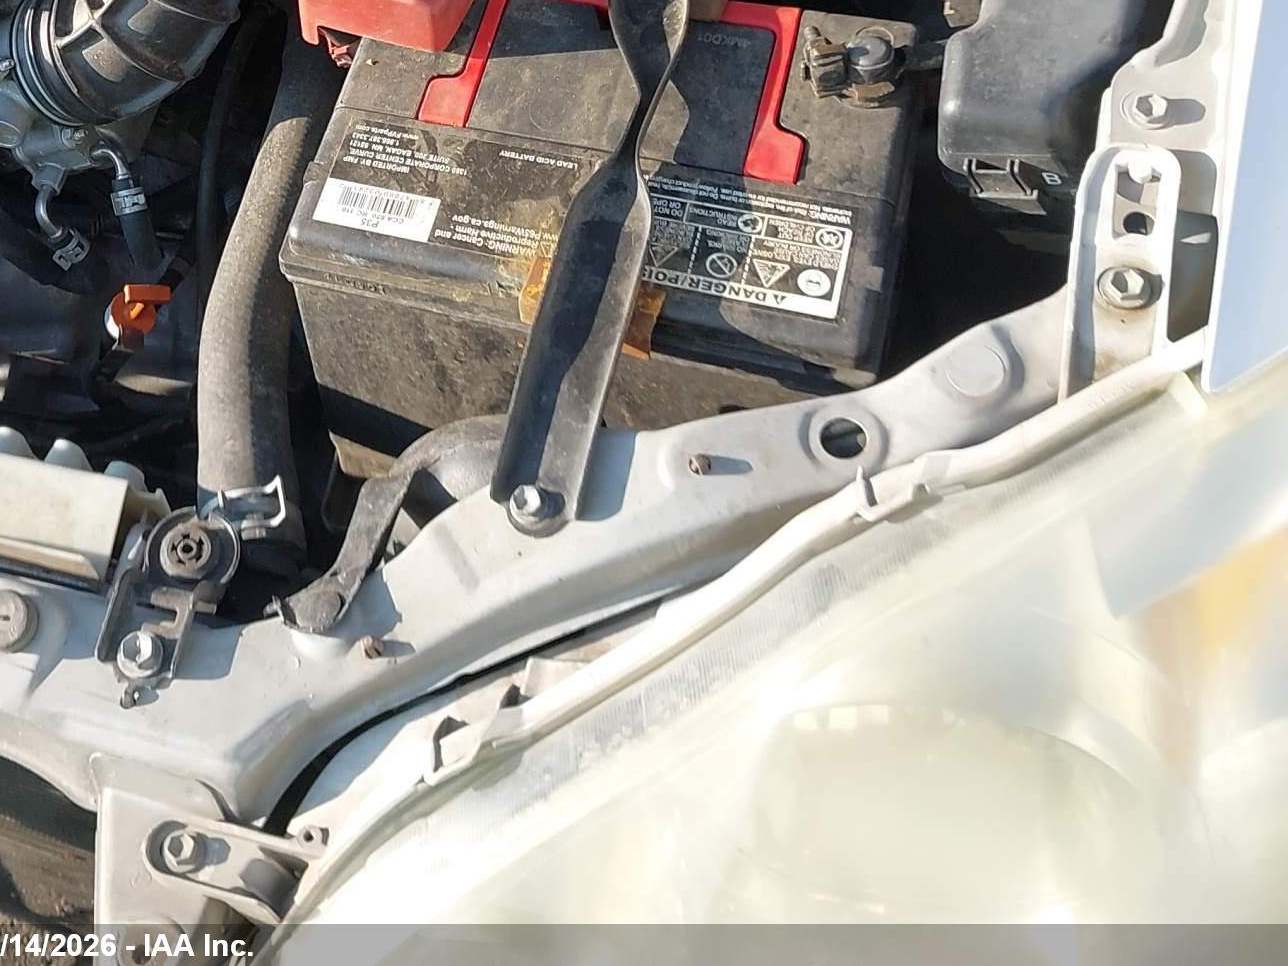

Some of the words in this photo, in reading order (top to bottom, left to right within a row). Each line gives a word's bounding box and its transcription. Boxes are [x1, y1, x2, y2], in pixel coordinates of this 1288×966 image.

[498, 149, 534, 161] BATTERY
[535, 156, 555, 165] ACID
[372, 160, 409, 173] IMPORTED
[556, 160, 577, 169] LEAD
[434, 228, 451, 240] and
